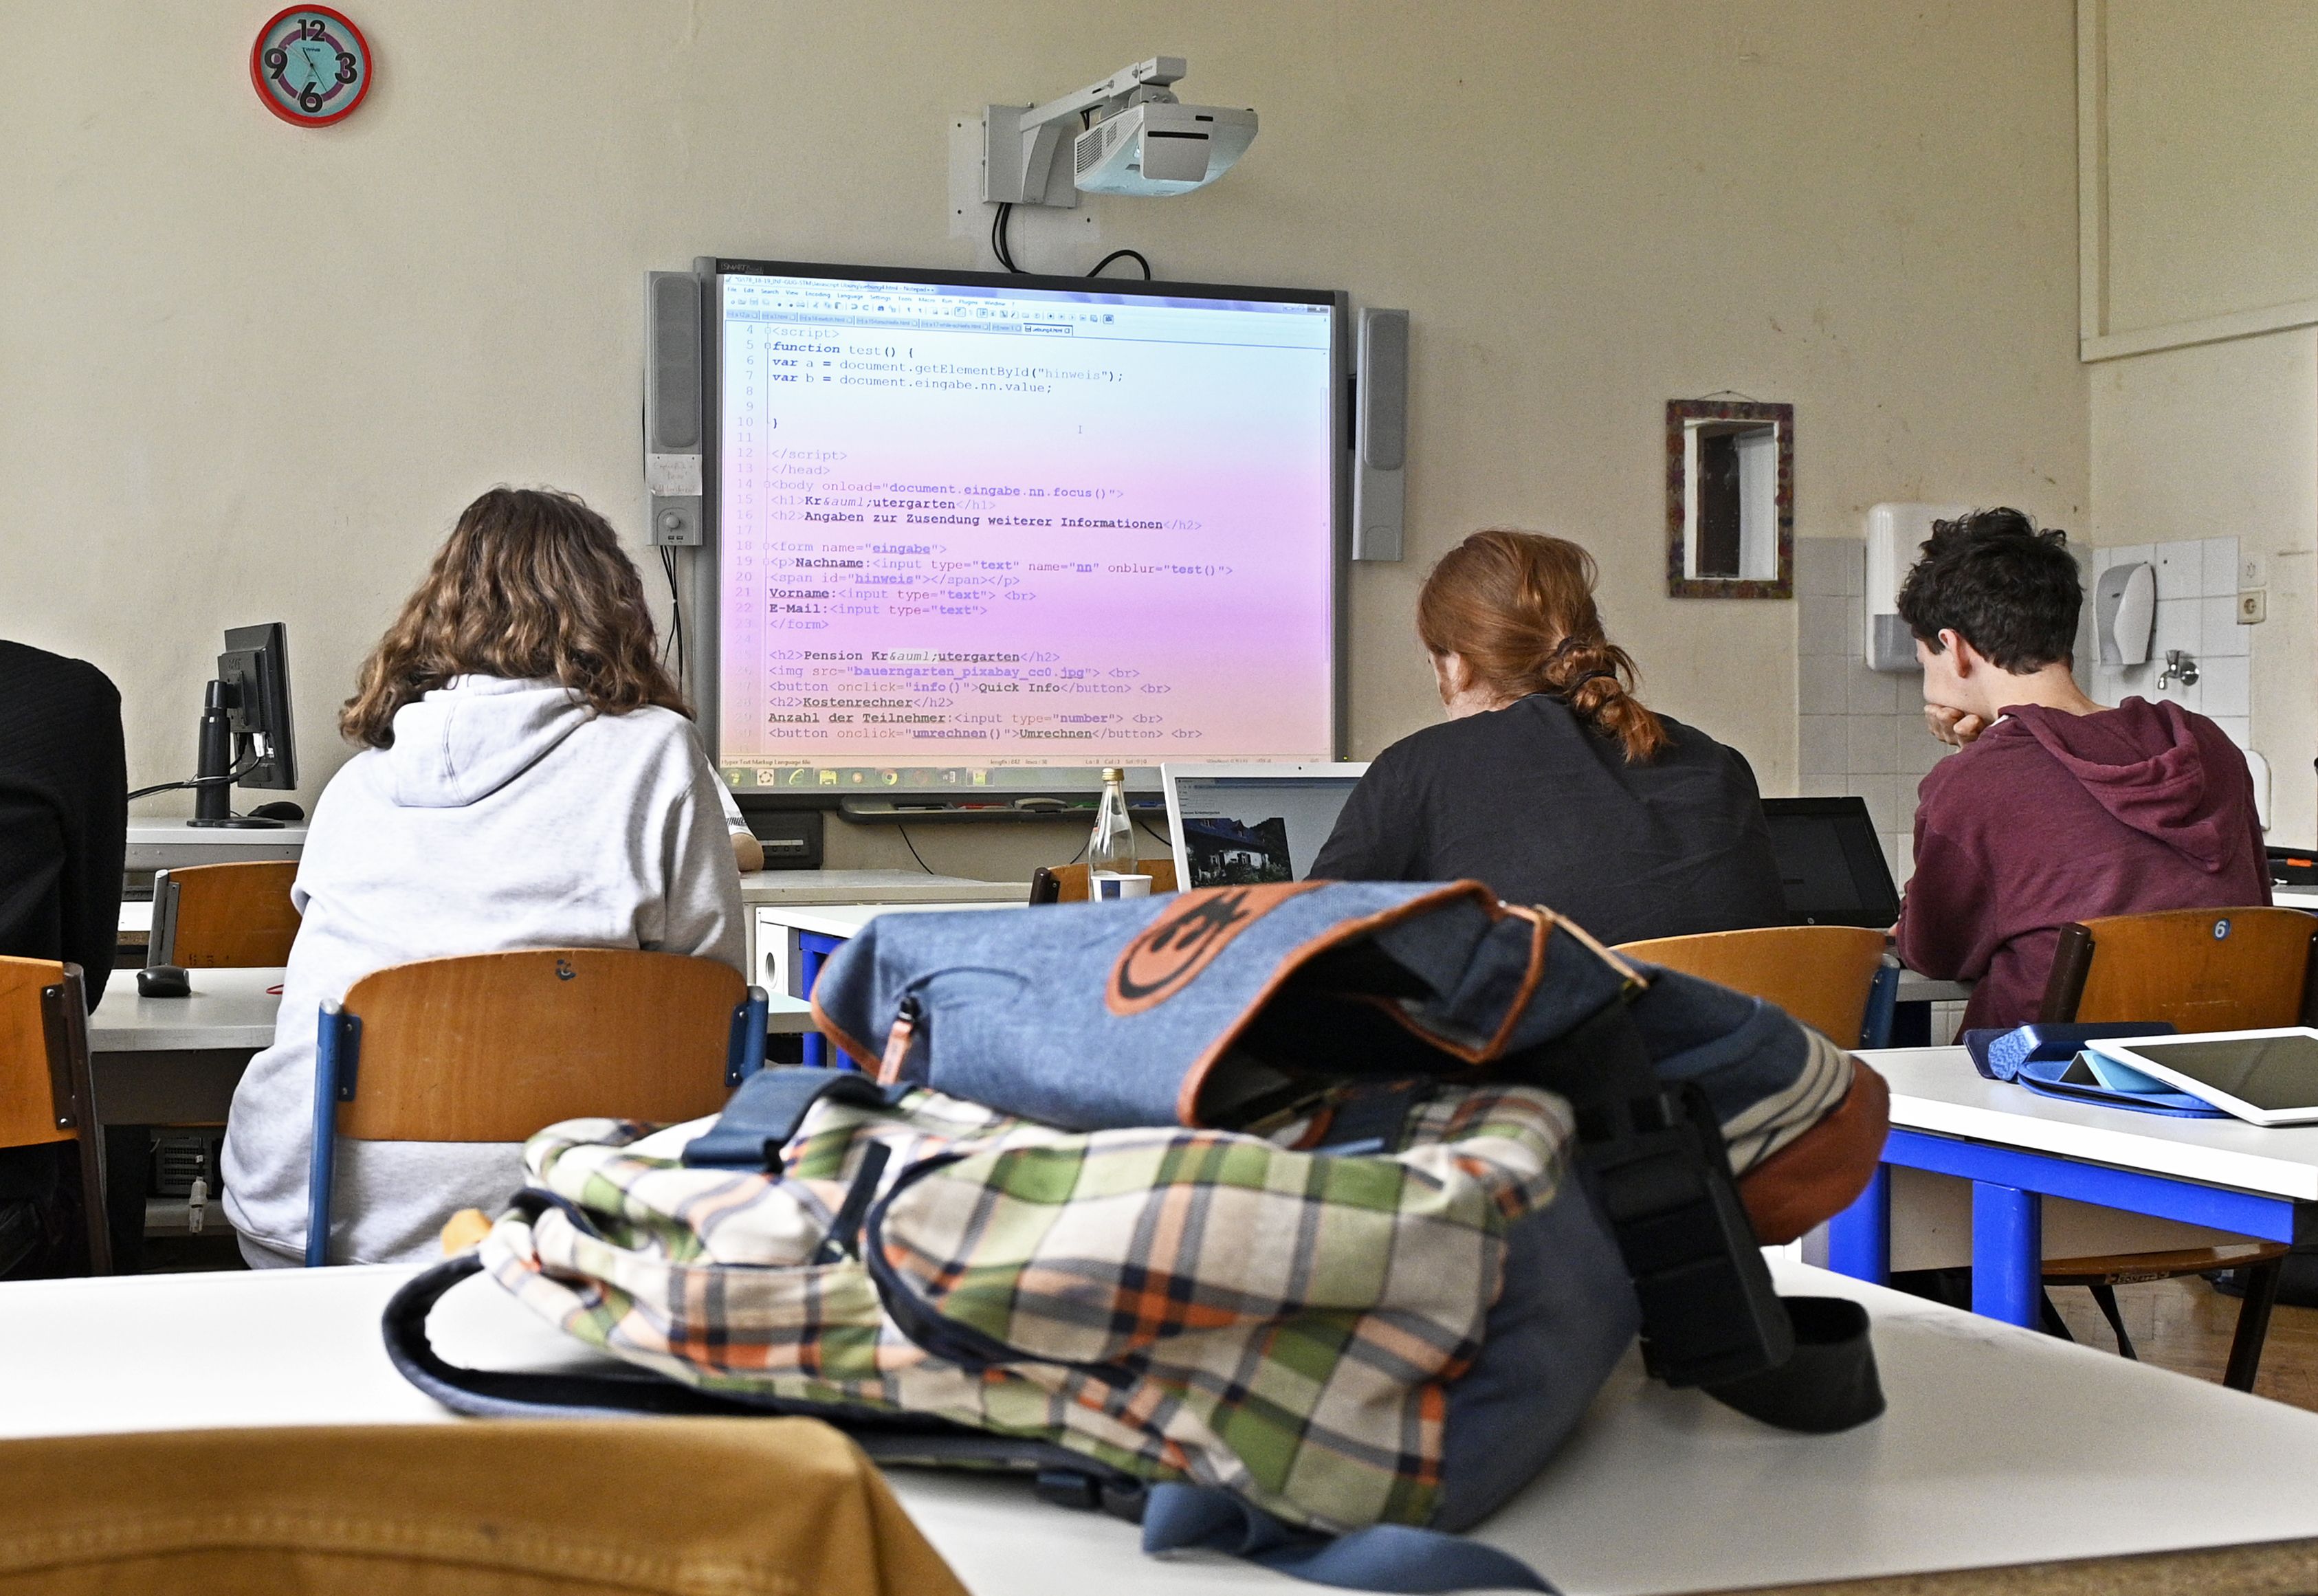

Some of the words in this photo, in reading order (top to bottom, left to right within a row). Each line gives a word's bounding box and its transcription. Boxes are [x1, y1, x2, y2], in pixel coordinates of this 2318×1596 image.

[297, 19, 327, 42] 12
[264, 48, 288, 80] 9
[335, 52, 358, 85] 3
[299, 82, 323, 113] 6
[747, 325, 753, 334] 4
[773, 326, 840, 339] <script>
[746, 340, 753, 349] 5
[772, 342, 840, 353] function
[850, 346, 895, 357] test()
[746, 356, 753, 365] 6
[772, 358, 797, 367] var
[839, 359, 1123, 382] document.getElementById("hinweis");
[746, 371, 753, 380] 7
[806, 373, 814, 382] b
[839, 375, 1052, 394] document.eingabe.nn.value;
[746, 386, 753, 395] 8
[746, 401, 753, 411] 9
[738, 417, 753, 427] 10
[737, 432, 753, 442] 11
[737, 448, 753, 457] 12
[771, 448, 848, 461] </script>
[737, 464, 753, 473] 13
[771, 465, 830, 476] </head>
[737, 480, 753, 489] 14
[771, 480, 814, 493] <body
[822, 483, 1124, 500] onload="document.eingabe.nn.focus()">
[737, 495, 753, 505] 15
[771, 495, 996, 510] <h1>Kr&auml;utergarten</h1>
[737, 510, 753, 520] 16
[771, 511, 864, 523] <h2>Angaben
[906, 513, 980, 526] Zusendung
[988, 516, 1052, 527] weiterer
[1061, 517, 1202, 530] Informationen</h2>
[737, 525, 752, 535] 17
[737, 541, 752, 550] 18
[771, 542, 814, 551] <form
[821, 543, 947, 555] name="eingabe">
[736, 557, 752, 566] 19
[771, 557, 922, 570] <p>Nachname:<input
[931, 559, 1019, 572] type="text"
[1028, 562, 1099, 573] name="nn"
[1107, 563, 1233, 576] onblur="test()">
[736, 572, 752, 581] 20
[771, 573, 813, 586] <span
[821, 572, 1020, 586] id="hinweis"></span></p>
[736, 588, 751, 597] 21
[769, 588, 889, 601] Vorname:<input
[898, 590, 996, 603] type="text">
[1004, 590, 1037, 601] <br>
[769, 604, 880, 616] E-Mail:<input
[889, 605, 988, 617] type="text">
[770, 619, 829, 630] </form>
[769, 650, 863, 661] <h2>Pension
[871, 650, 1060, 663] Kr&auml;utergarten</h2>
[769, 665, 804, 677] <img
[1108, 668, 1140, 678] <br>
[769, 681, 828, 692] <button
[837, 682, 1019, 694] onclick="info()">Quick
[1028, 683, 1132, 695] Info</button>
[1140, 684, 1171, 694] <br>
[769, 697, 954, 709] <h2>Kostenrechner</h2>
[768, 713, 820, 722] Anzahl
[828, 712, 854, 722] der
[862, 713, 1003, 725] Teilnehmer:<input
[1011, 713, 1124, 725] type="number">
[1132, 713, 1163, 724] <br>
[769, 728, 828, 739] <button
[837, 728, 1164, 741] onclick="umrechnen()">Umrechnen</button>
[1171, 729, 1202, 740] <br>
[2215, 920, 2227, 938] 6
